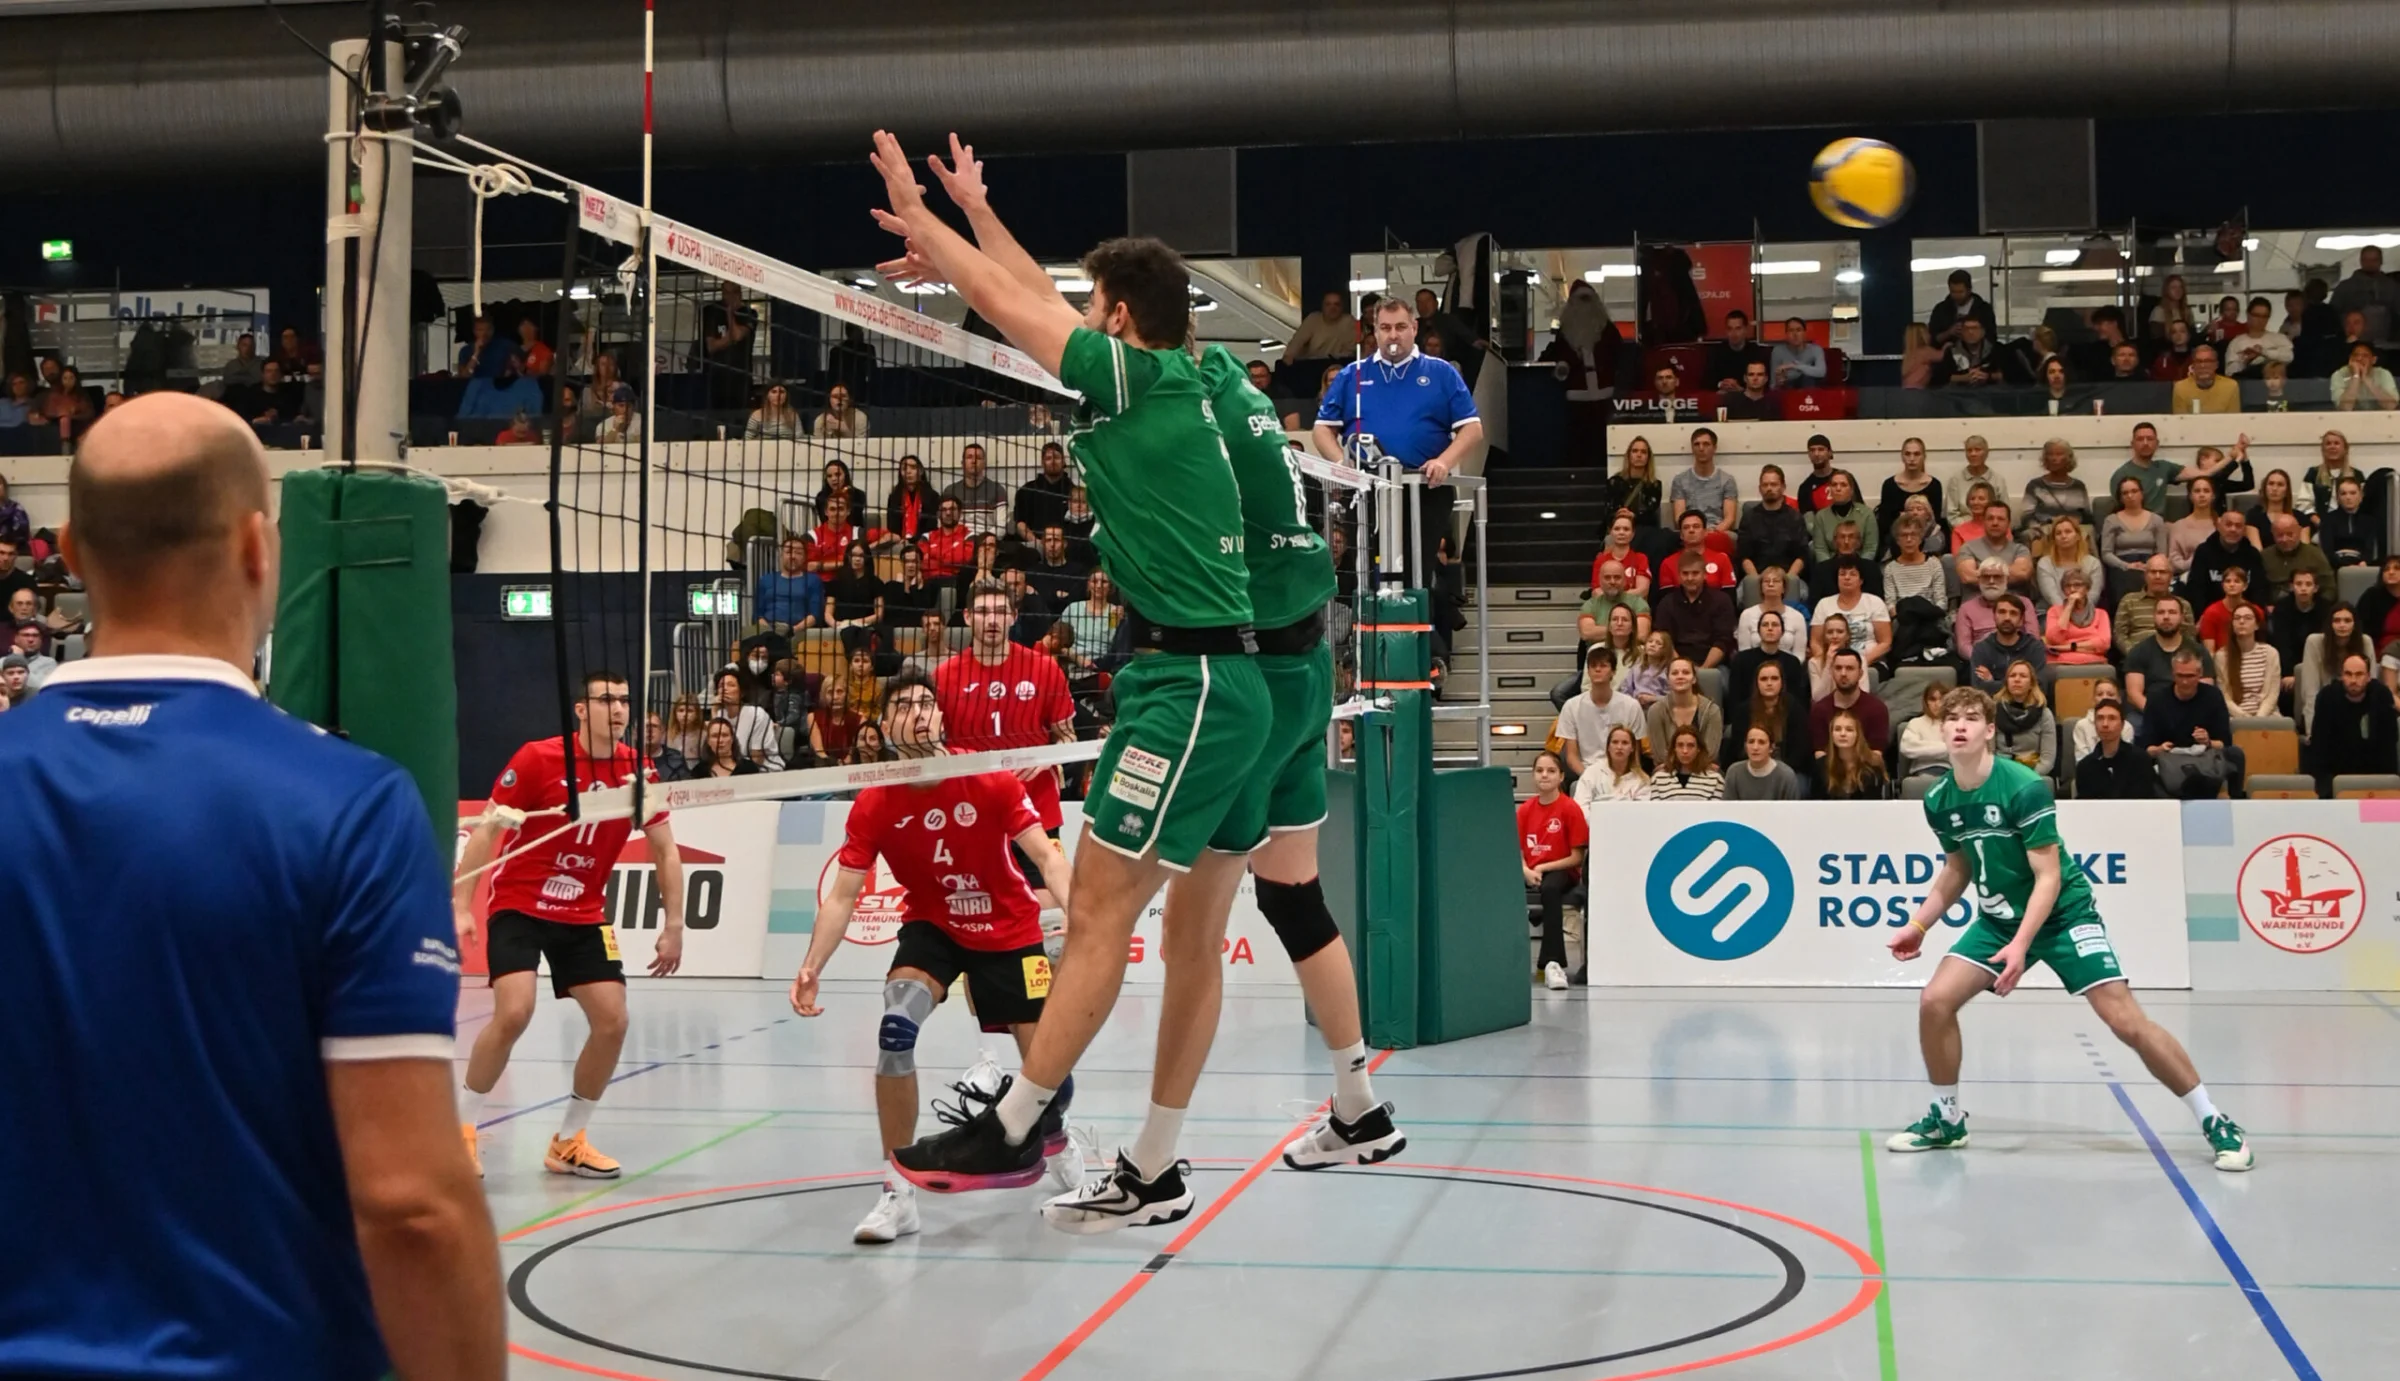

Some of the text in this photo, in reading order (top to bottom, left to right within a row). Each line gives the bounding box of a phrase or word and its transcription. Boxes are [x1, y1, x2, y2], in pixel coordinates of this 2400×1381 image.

[677, 234, 701, 261] OSPA
[708, 245, 765, 285] Unternehmen
[1699, 290, 1731, 299] SPA.DE
[1612, 398, 1699, 411] VIP LOGE
[1798, 404, 1820, 412] OSPA
[66, 703, 153, 725] capelli
[991, 711, 1001, 736] 1
[1120, 776, 1157, 798] Boskalis
[933, 838, 954, 866] 4
[1818, 853, 2127, 885] STADKE
[935, 873, 980, 890] OKA
[851, 913, 902, 923] RNEMÜN
[2261, 919, 2346, 930] WARNEMÜNDE
[2293, 931, 2315, 940] 1949
[1030, 977, 1051, 988] LOT
[1940, 1096, 1956, 1106] VS
